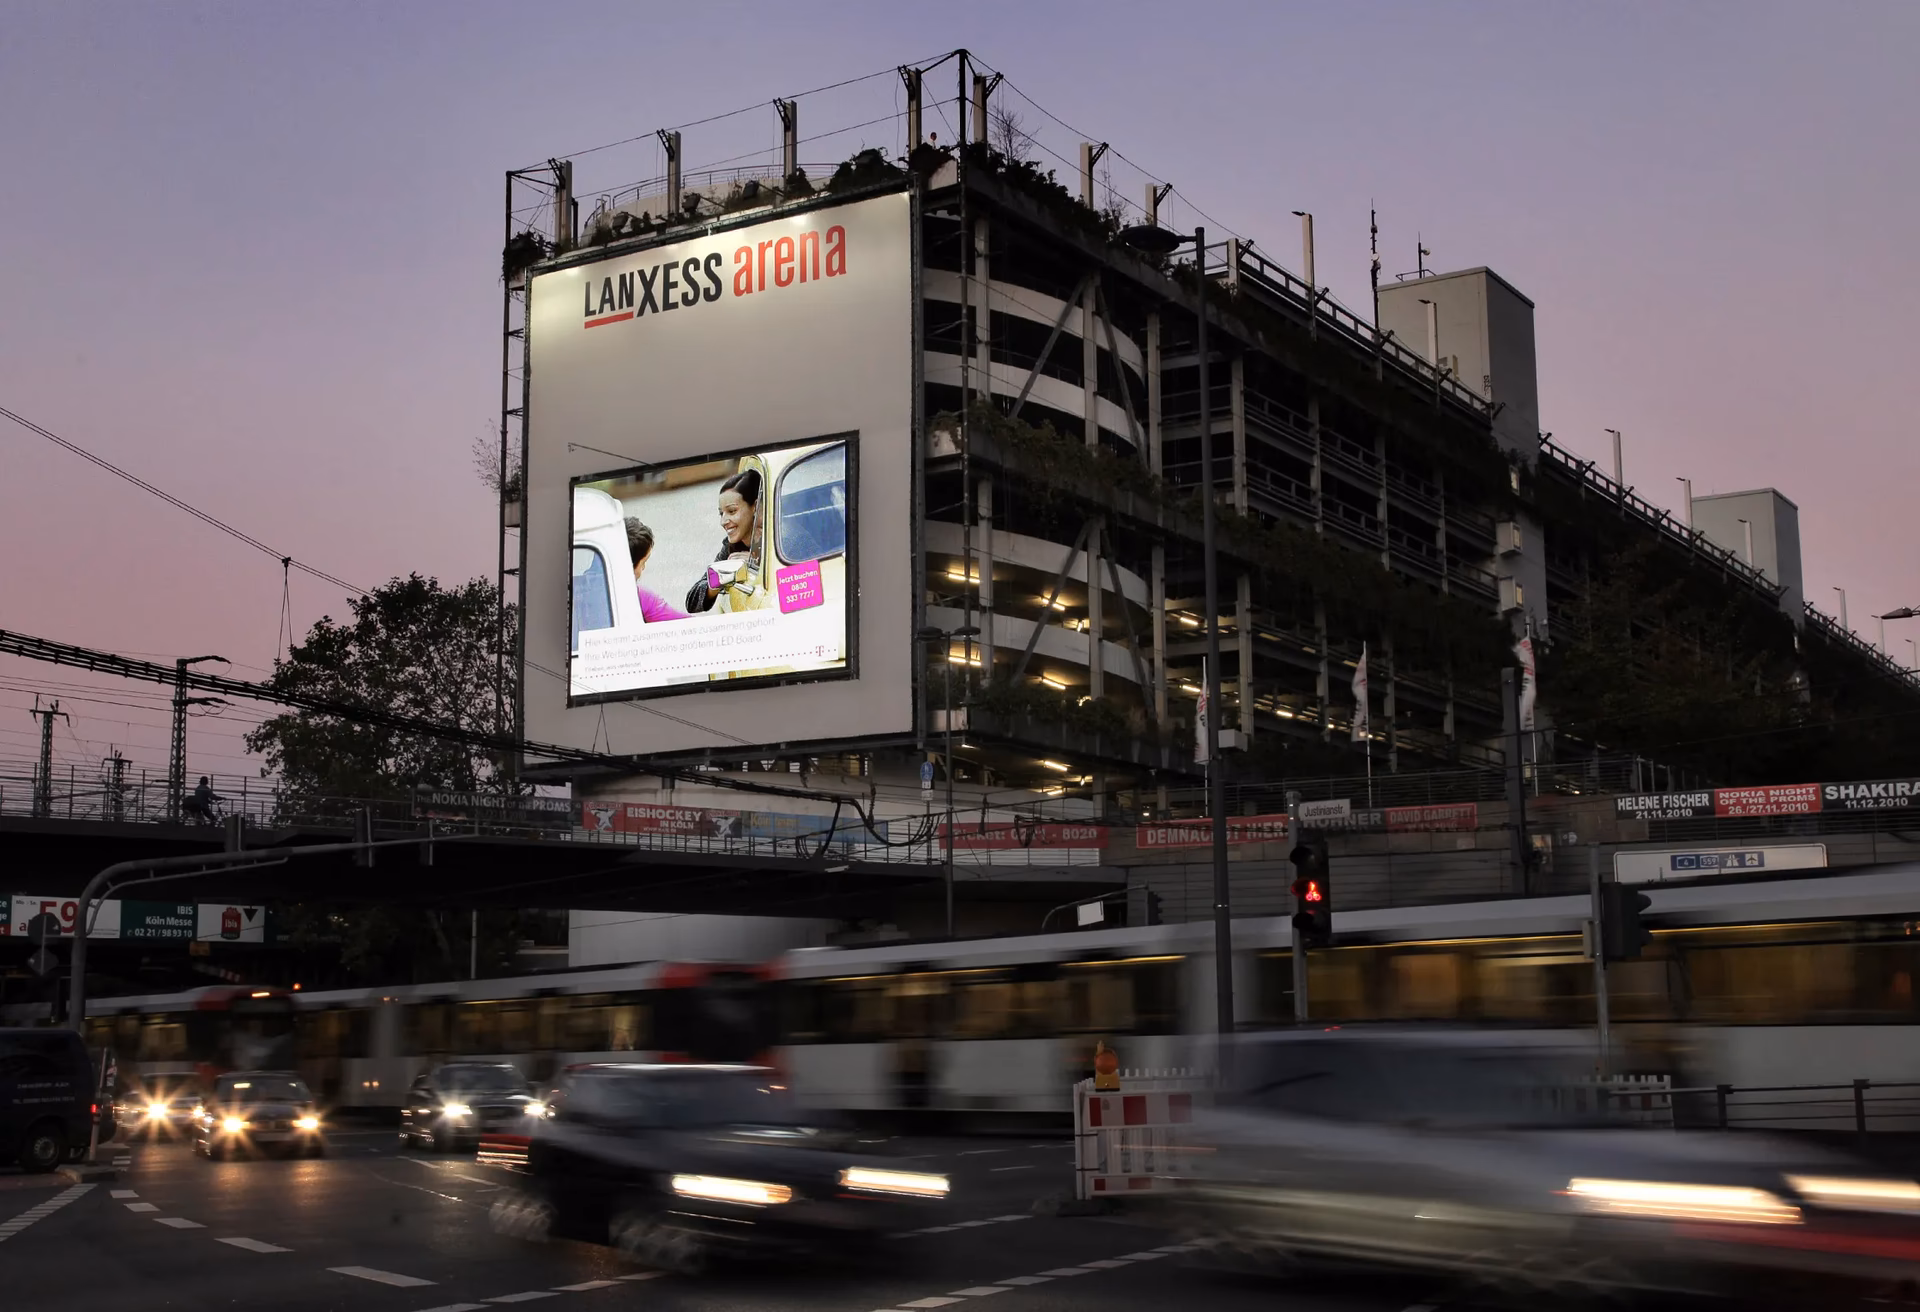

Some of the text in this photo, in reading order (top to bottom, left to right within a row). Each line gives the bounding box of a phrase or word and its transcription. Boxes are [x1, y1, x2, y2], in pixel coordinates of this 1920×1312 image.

[584, 224, 846, 318] LANXESS arena
[778, 569, 819, 585] Jetzt buchen
[791, 581, 808, 592] 0800
[785, 589, 815, 604] 333 7777
[681, 628, 698, 636] was
[699, 621, 745, 635] zusammen
[602, 648, 639, 659] Werbung
[640, 645, 654, 656] auf
[716, 635, 734, 647] LED
[1719, 787, 1816, 799] NOKIA NIGHT
[1824, 781, 1920, 800] SHAKIRA
[432, 792, 469, 806] NOKIA
[471, 795, 506, 809] NIGHT
[533, 799, 571, 813] PROMS
[1617, 793, 1710, 811] HELENE FISCHER
[1740, 796, 1767, 804] THE
[1770, 793, 1816, 802] PROMS
[1845, 797, 1908, 809] 11.12.2010
[626, 807, 702, 822] EISHOCKEY
[1304, 804, 1346, 818] Justinianstr.
[1390, 806, 1472, 823] DAVID GARRETT
[1635, 808, 1693, 820] 21.11.2010
[1728, 802, 1808, 815] 26./27.11.2010
[659, 820, 669, 828] IN
[671, 819, 694, 830] KÖLN
[1062, 827, 1097, 840] 8020
[1702, 857, 1717, 866] 559
[177, 905, 194, 915] IBIS
[145, 915, 193, 927] Köln Messe
[134, 928, 145, 936] 02
[146, 928, 156, 937] 21
